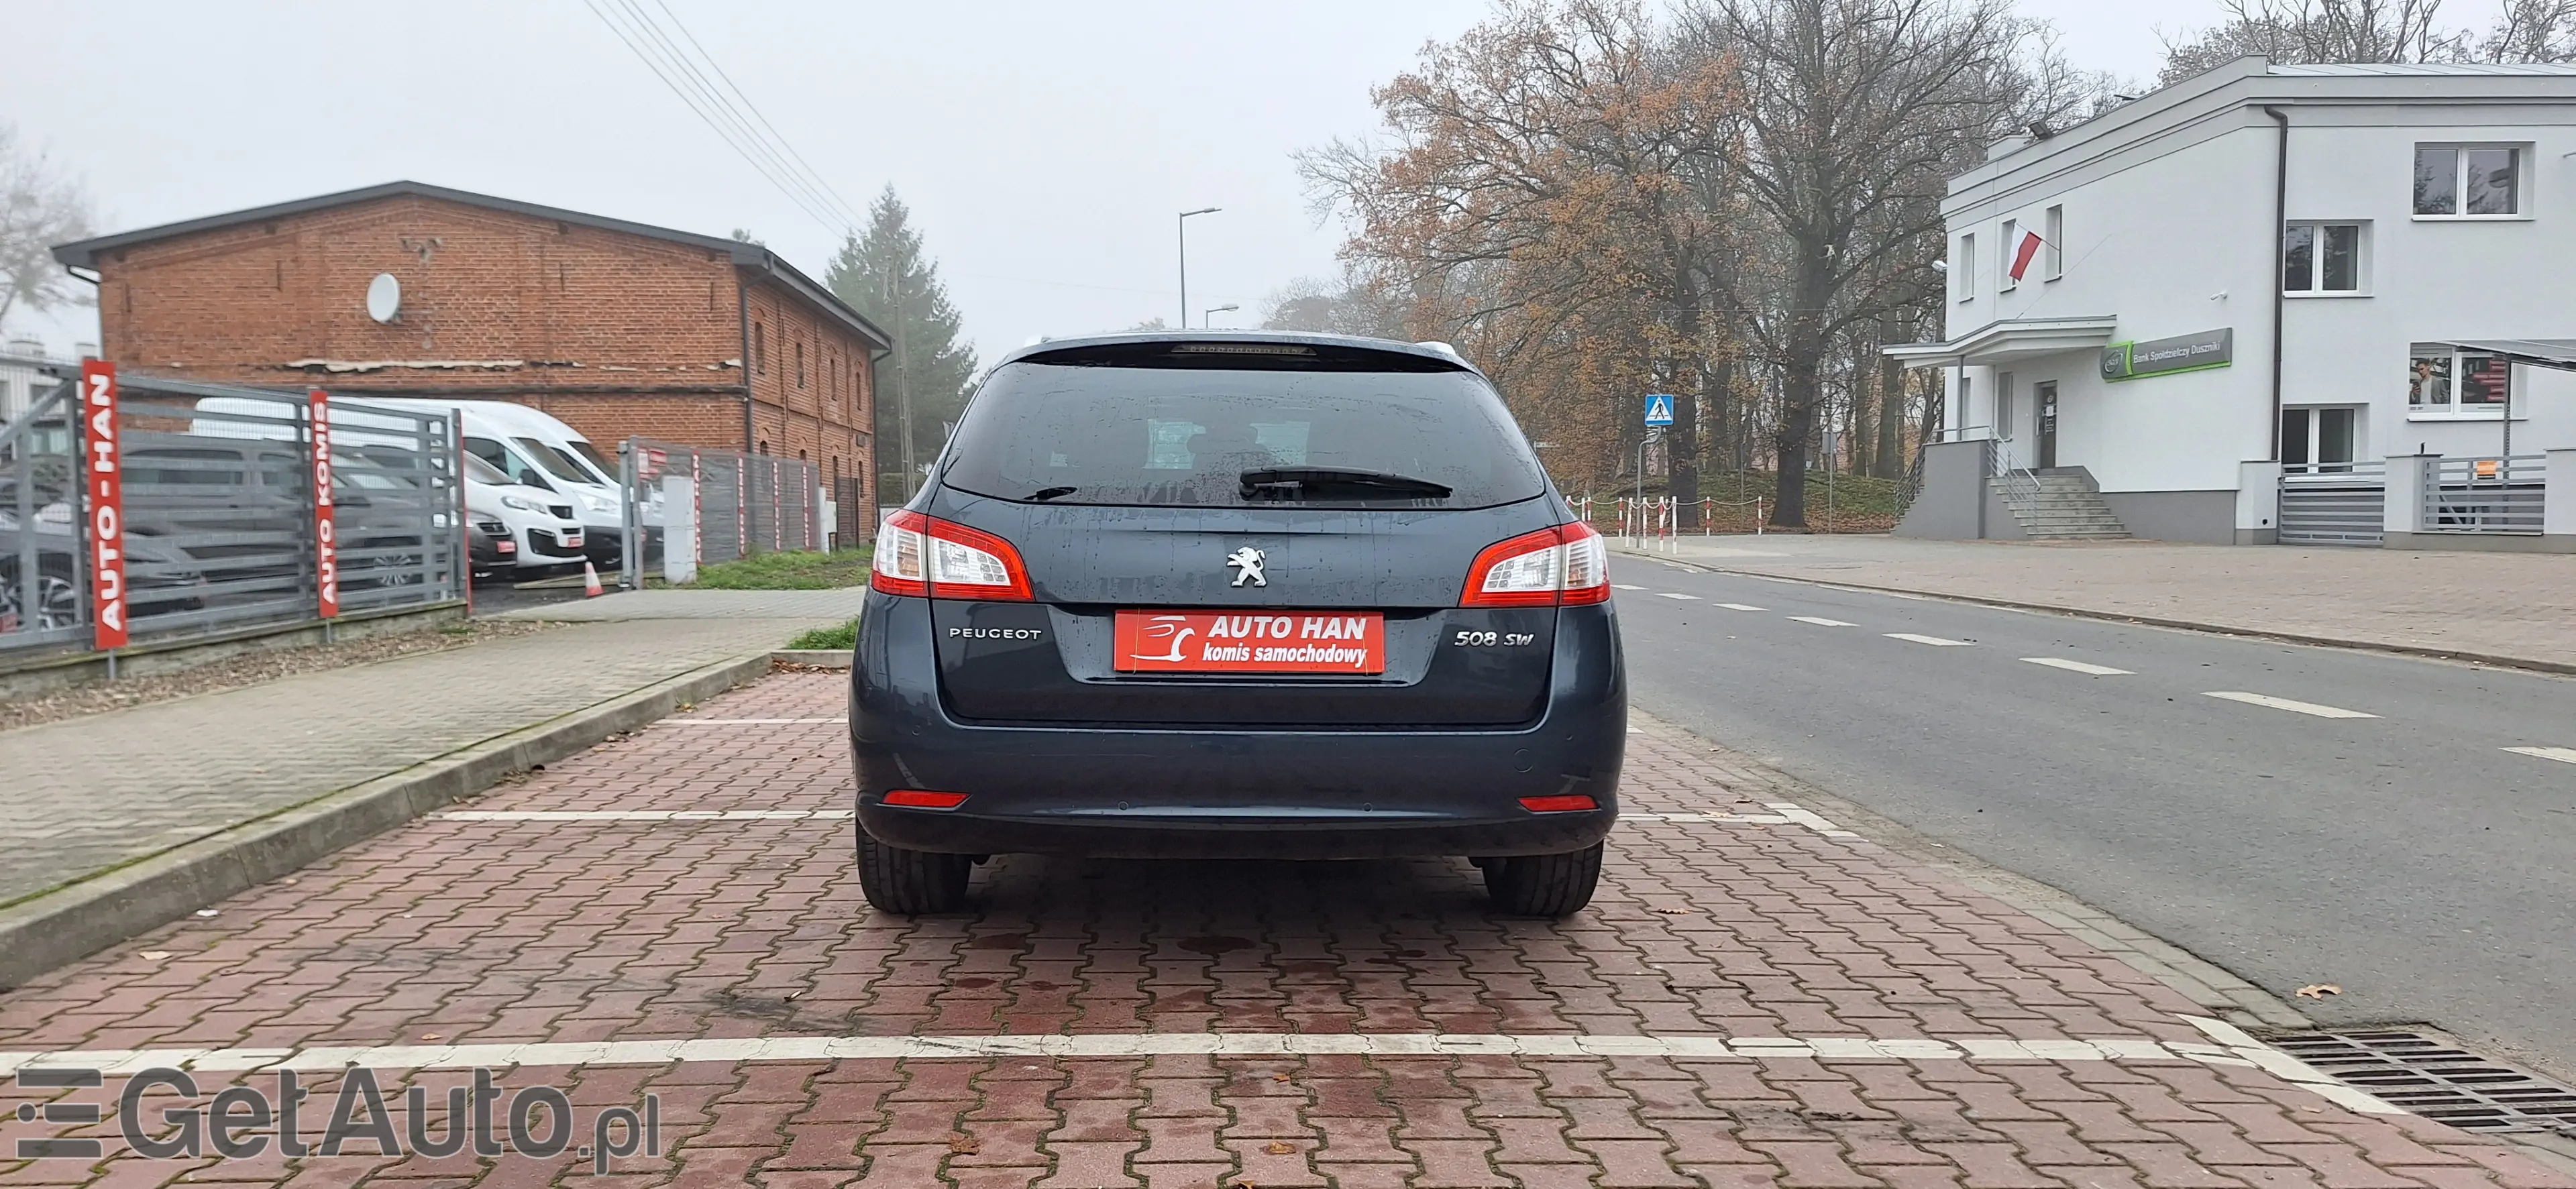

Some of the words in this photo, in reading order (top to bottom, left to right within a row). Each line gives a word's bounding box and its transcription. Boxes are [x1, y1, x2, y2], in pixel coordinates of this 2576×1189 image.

[2133, 354, 2149, 363] Bank
[2191, 341, 2220, 354] Duszniki
[90, 374, 114, 473] HAN
[314, 402, 331, 506] KOMIS
[692, 454, 700, 496] HAN
[97, 505, 122, 631] AUTO
[319, 518, 335, 604] AUTO
[949, 628, 1042, 640] PEUGEOT
[1208, 616, 1292, 639] AUTO
[1301, 617, 1366, 640] HAN
[1454, 631, 1497, 646] 508
[1503, 634, 1534, 646] SW
[1203, 642, 1250, 662] komis
[1254, 643, 1368, 668] samochodowy
